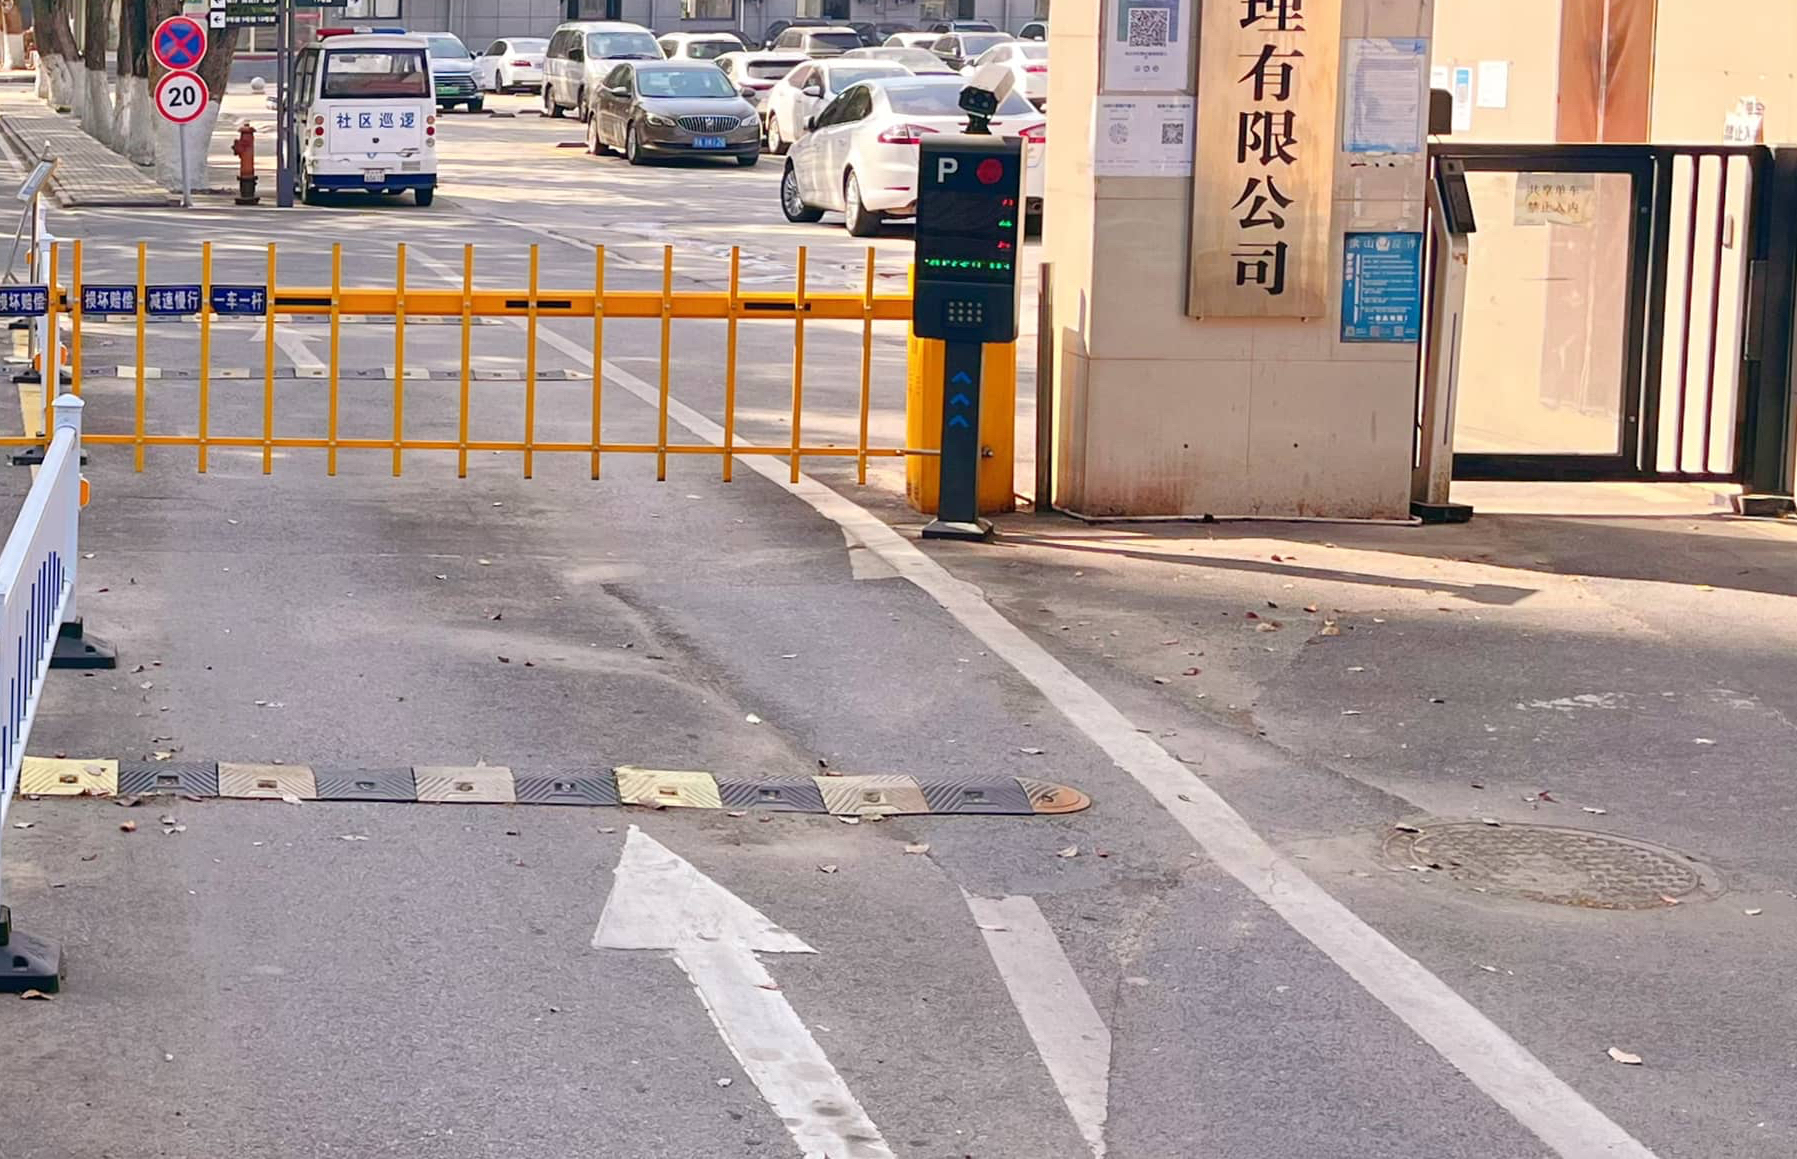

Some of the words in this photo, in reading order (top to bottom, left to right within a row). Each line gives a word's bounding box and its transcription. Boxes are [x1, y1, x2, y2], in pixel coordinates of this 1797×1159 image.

[168, 86, 195, 107] 20
[336, 112, 415, 129] 社区巡逻
[937, 157, 958, 183] P
[85, 291, 134, 309] 损坏赔偿
[149, 291, 199, 310] 减速慢行
[214, 291, 264, 310] 一车一杆
